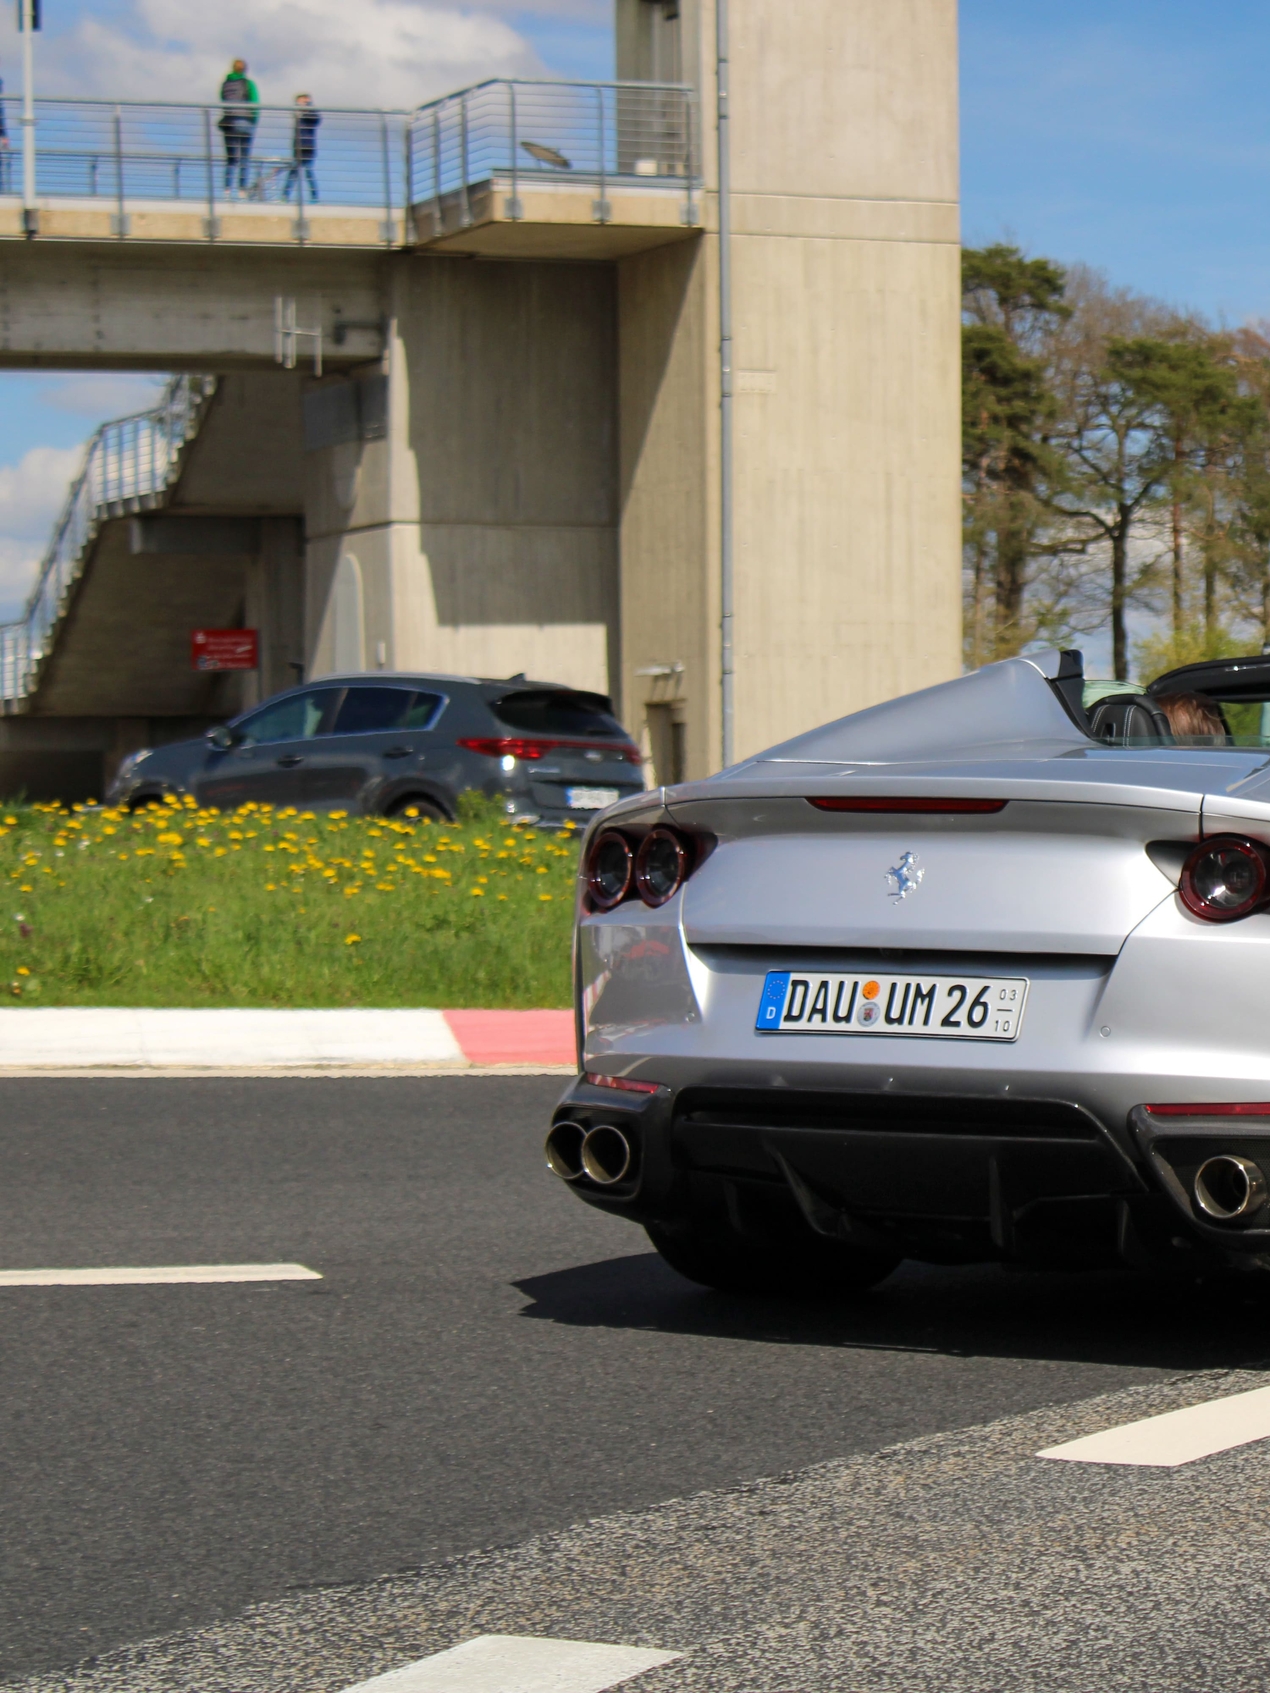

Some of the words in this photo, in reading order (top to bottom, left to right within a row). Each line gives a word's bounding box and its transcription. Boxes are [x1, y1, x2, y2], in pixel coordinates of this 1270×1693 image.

[999, 988, 1018, 1001] 03
[784, 979, 860, 1024] DAU
[884, 981, 938, 1026] UM
[940, 984, 992, 1029] 26
[765, 1006, 777, 1020] D
[994, 1019, 1012, 1032] 10
